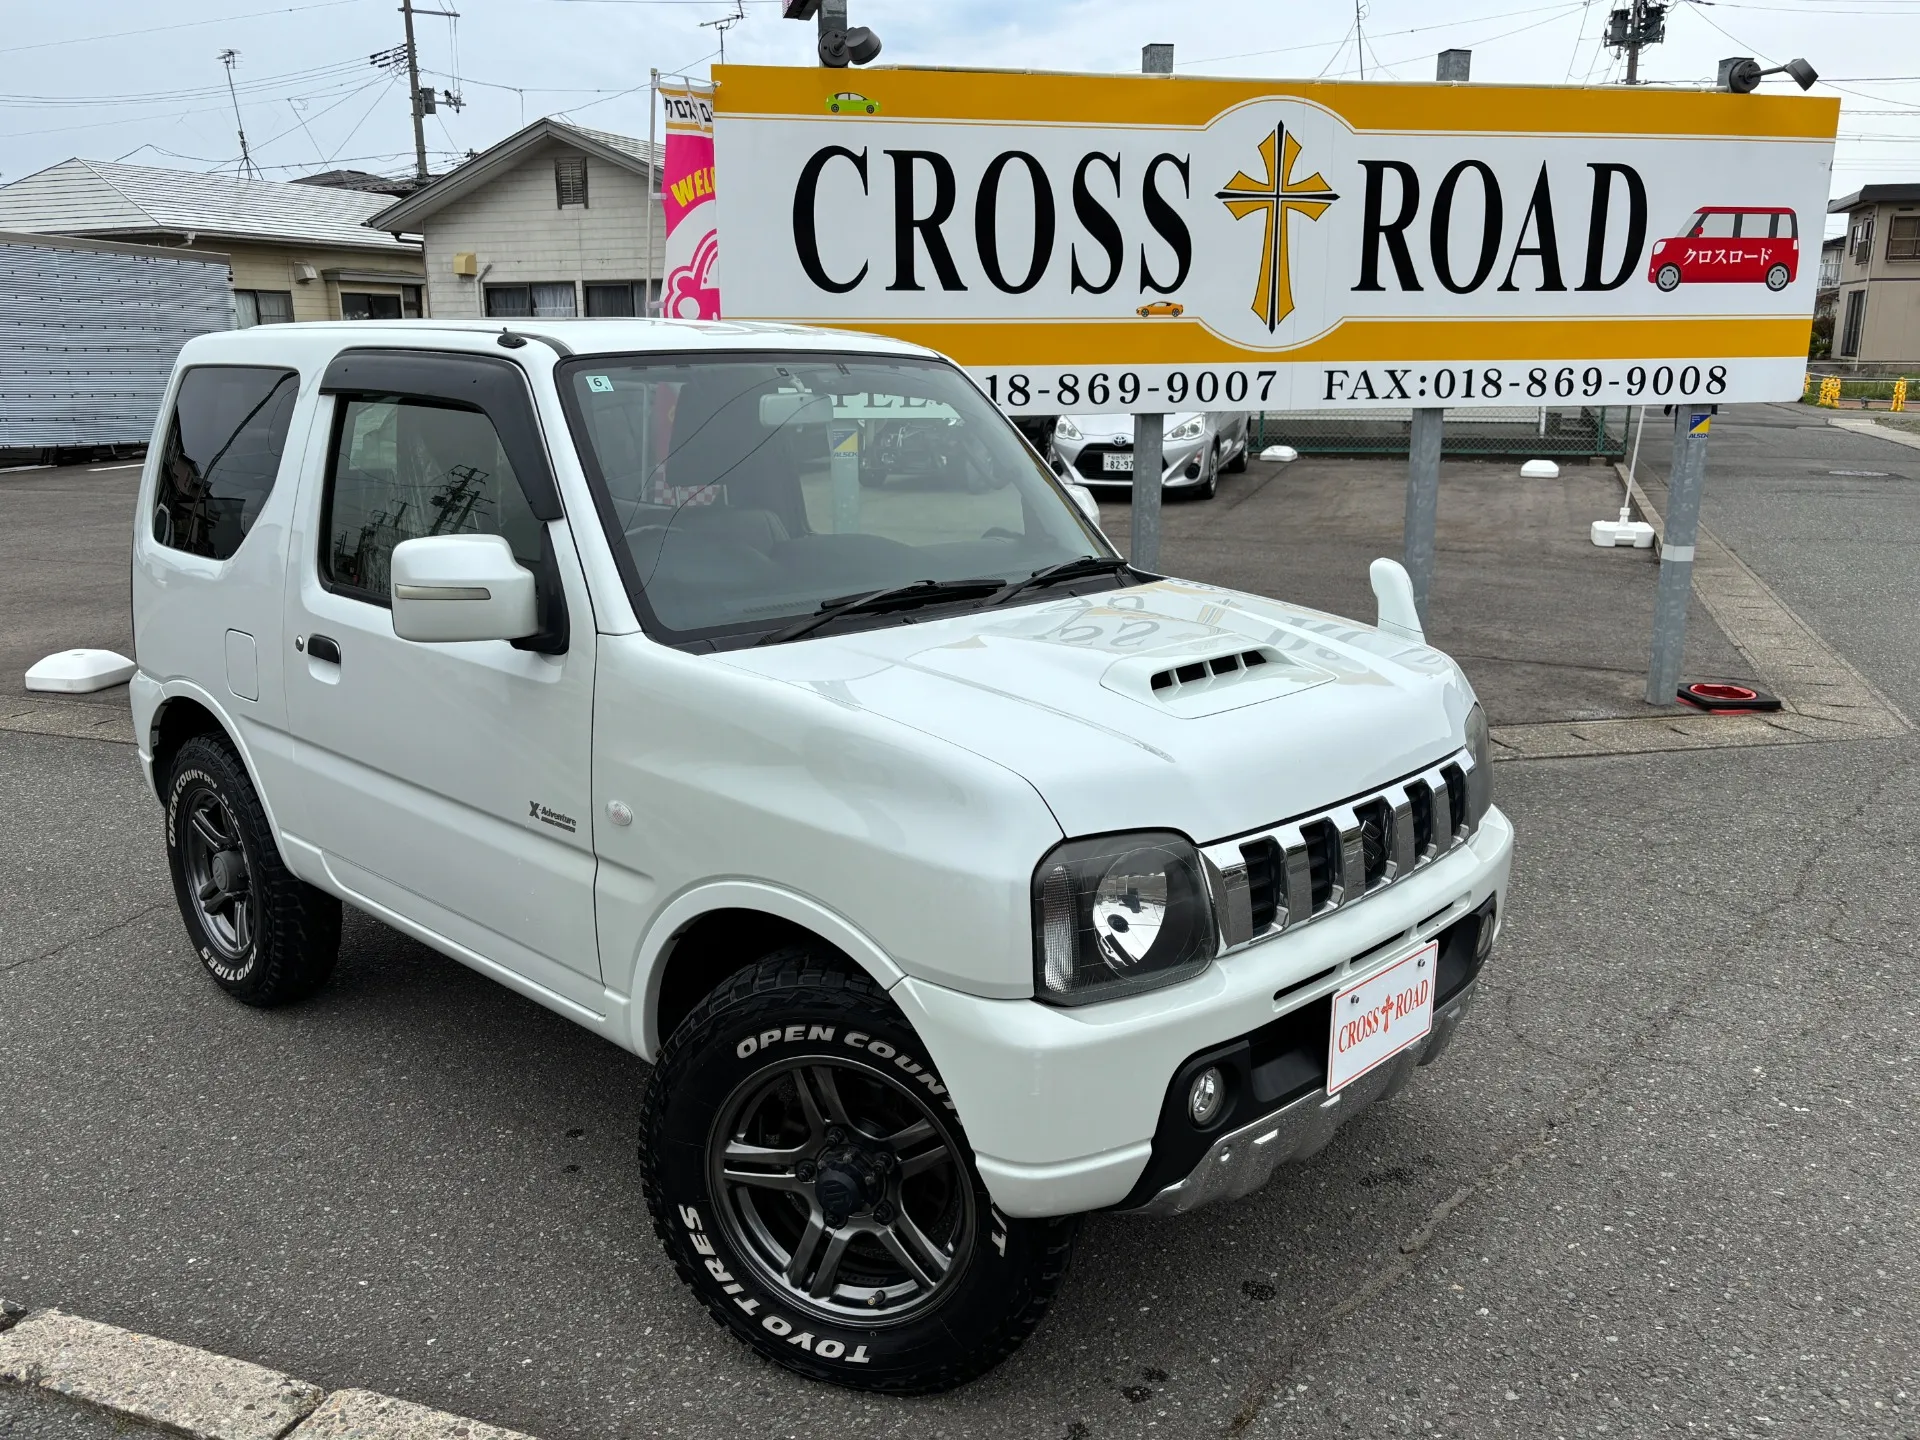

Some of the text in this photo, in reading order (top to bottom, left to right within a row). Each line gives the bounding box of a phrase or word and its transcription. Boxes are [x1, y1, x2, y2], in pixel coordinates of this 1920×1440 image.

[665, 97, 712, 122] クロスロ
[792, 146, 1648, 295] CROSS ROAD
[1683, 248, 1772, 266] クロスロード
[593, 377, 603, 387] 6
[168, 794, 179, 848] OPEN
[176, 768, 218, 795] COUNTRY
[201, 946, 236, 981] TIRES
[1338, 979, 1429, 1053] CROSS ROAD
[735, 1024, 837, 1060] OPEN
[843, 1031, 962, 1126] COUN
[678, 1203, 871, 1365] TOYO TIRES
